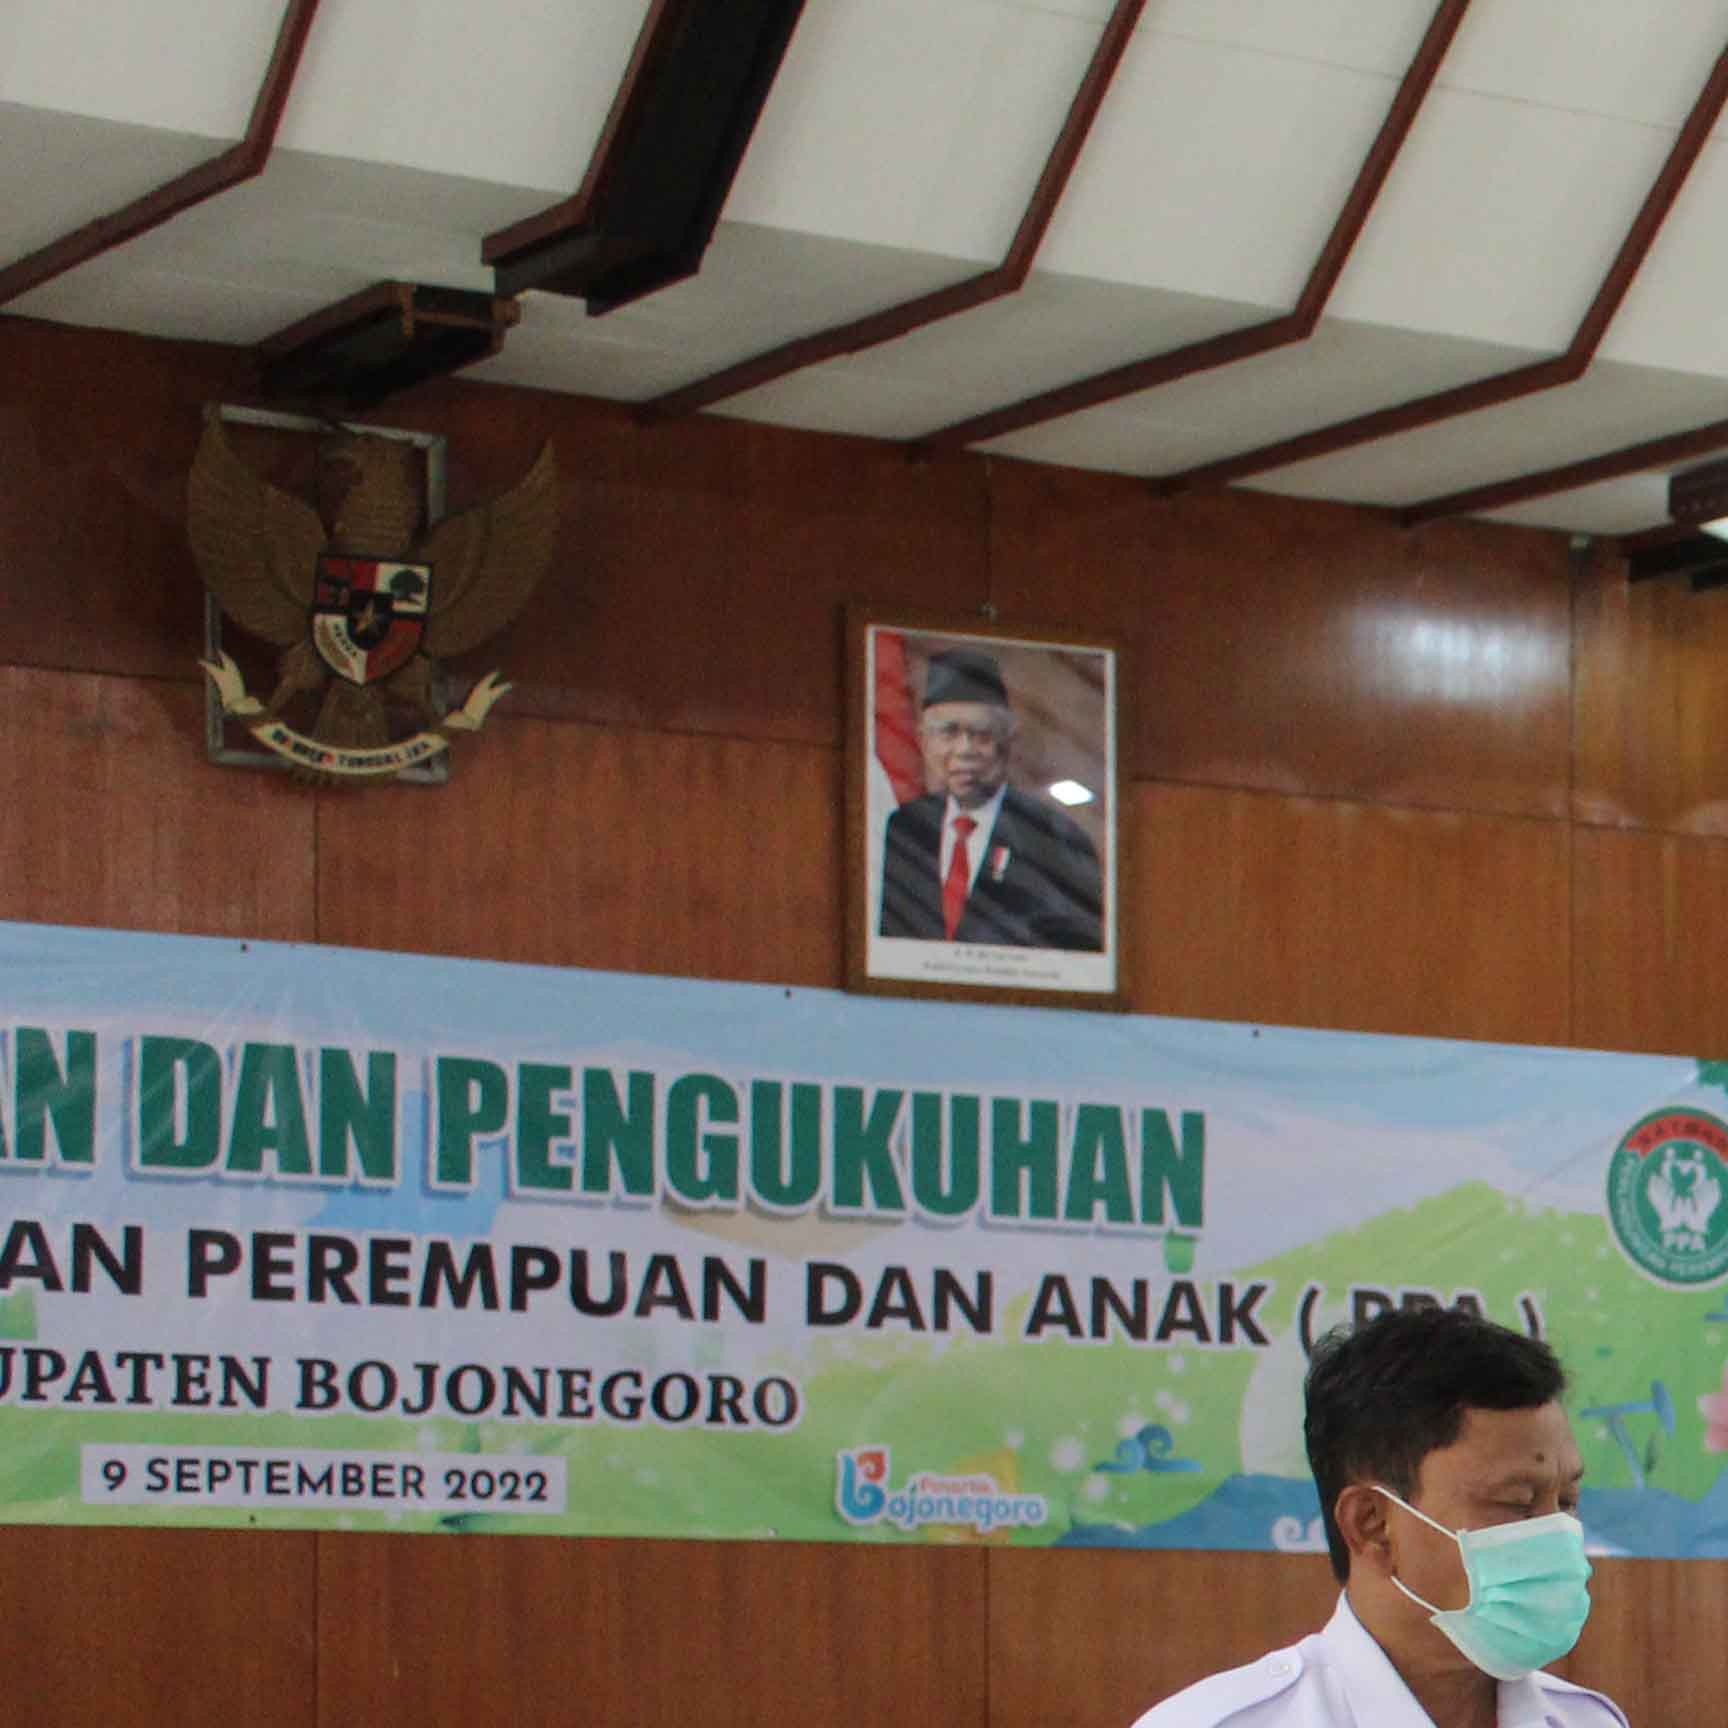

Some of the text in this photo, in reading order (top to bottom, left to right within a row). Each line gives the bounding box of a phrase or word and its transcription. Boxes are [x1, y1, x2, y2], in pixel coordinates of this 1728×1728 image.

[0, 1026, 1205, 1228] N DAN PENGUKUHAN
[0, 1220, 143, 1296] AN
[187, 1228, 767, 1325] PEREMPUAN
[806, 1262, 993, 1335] DAN
[1026, 1275, 1270, 1345] ANAK
[296, 1358, 799, 1427] BOJONEGORO
[102, 1458, 549, 1502] 9 SEPTEMBER 2022
